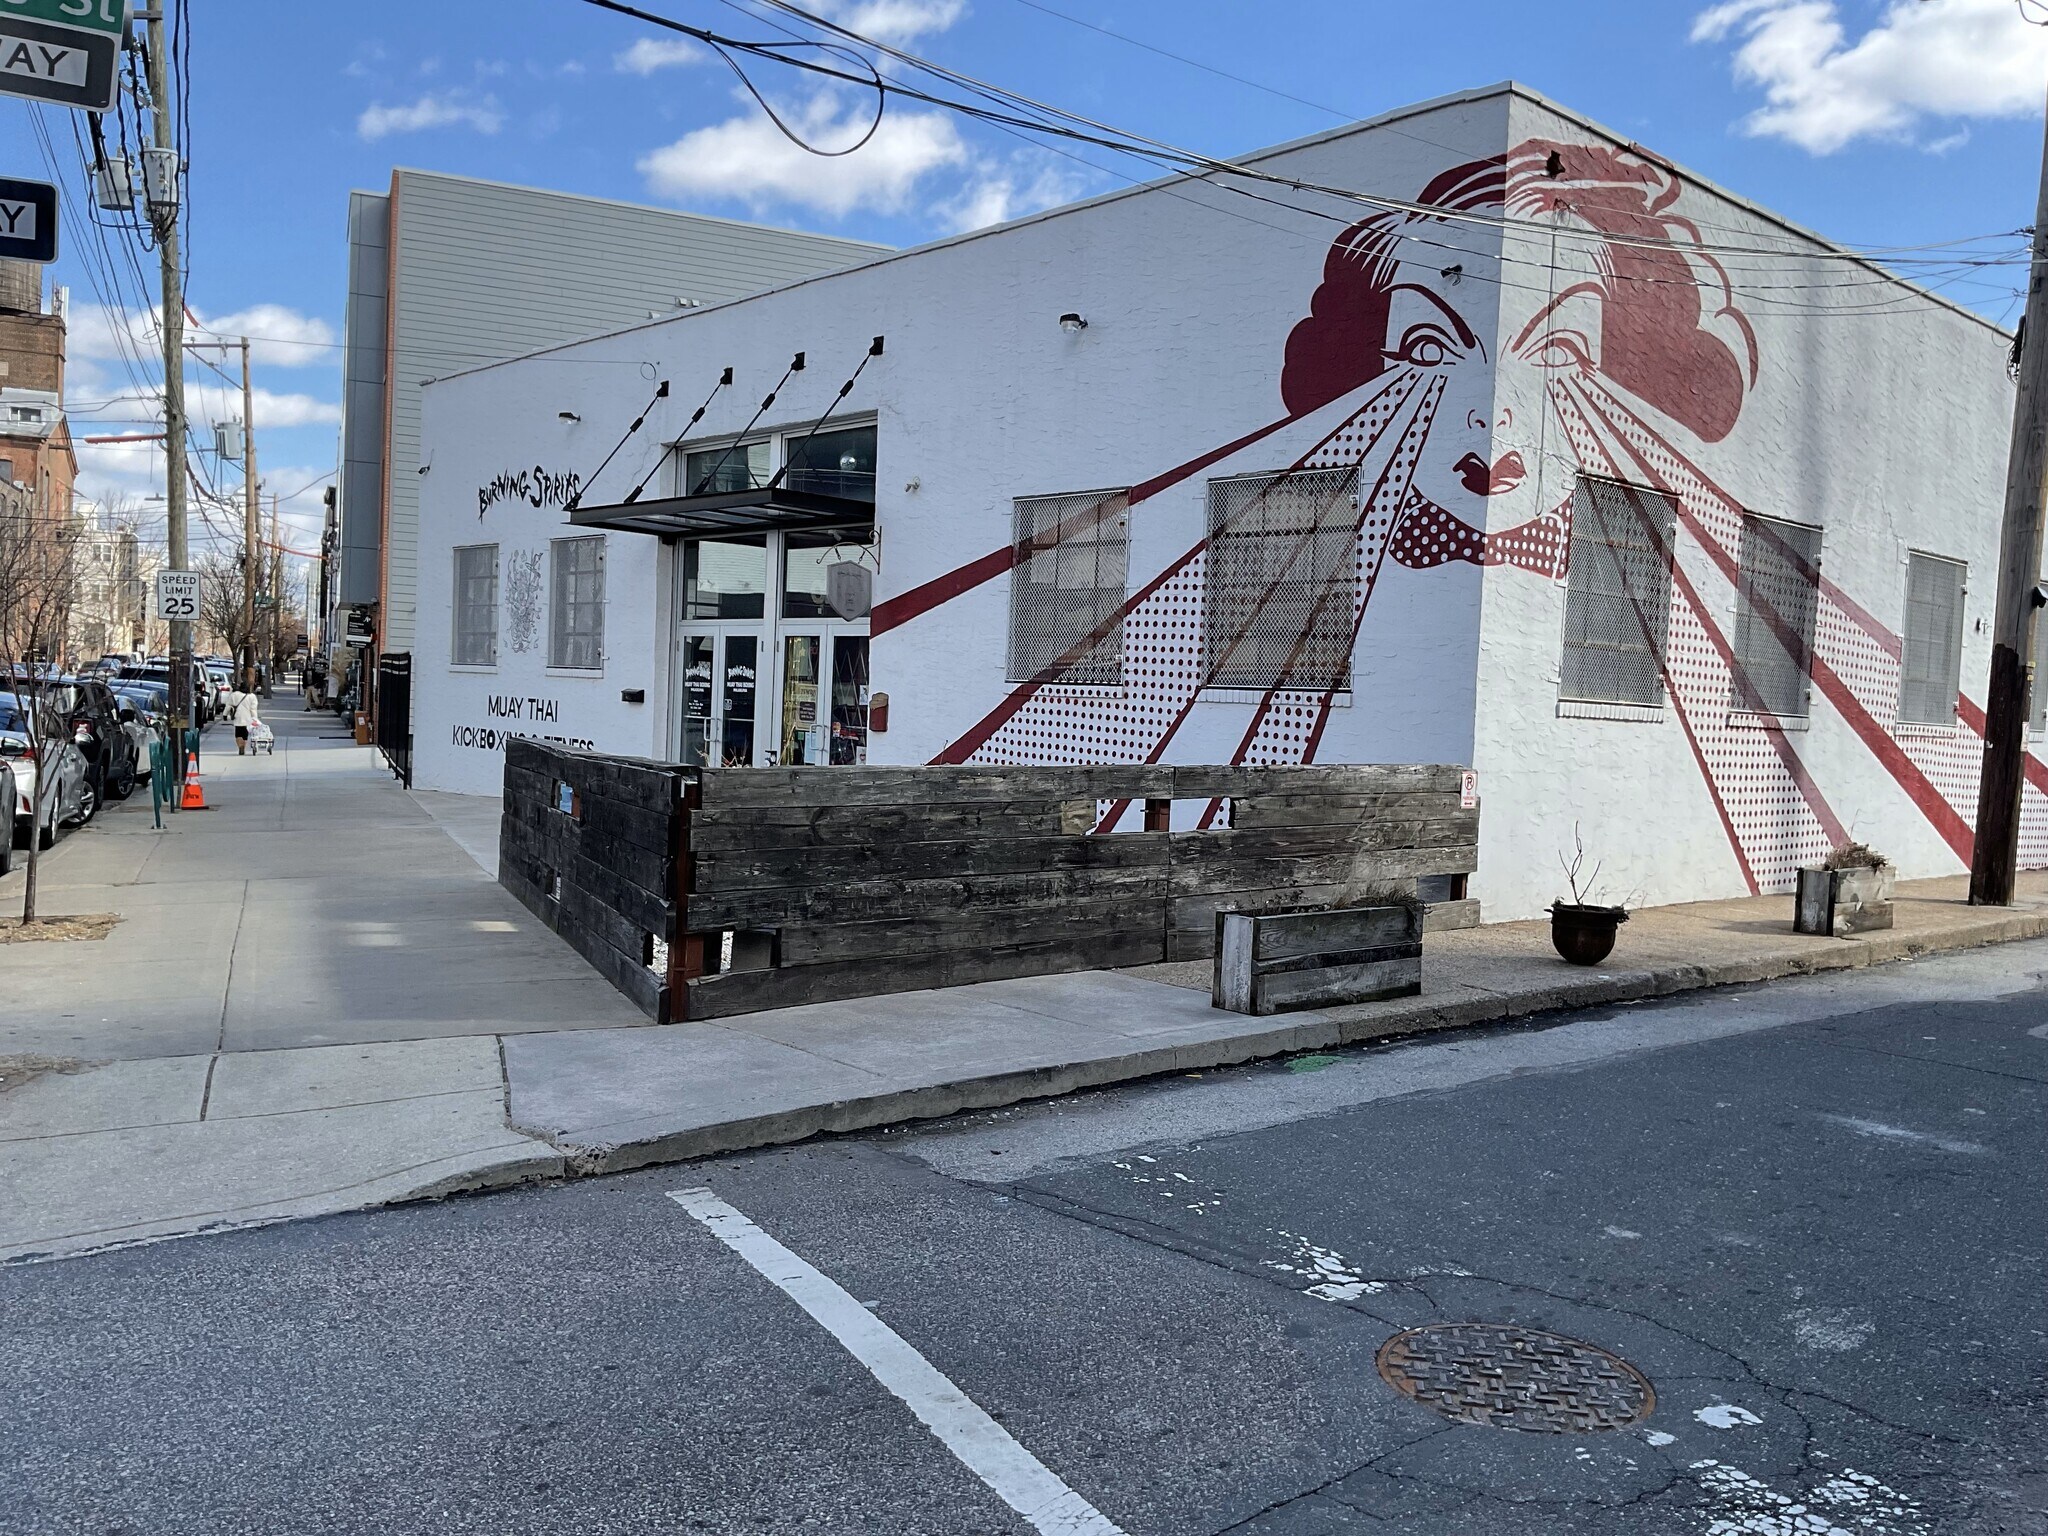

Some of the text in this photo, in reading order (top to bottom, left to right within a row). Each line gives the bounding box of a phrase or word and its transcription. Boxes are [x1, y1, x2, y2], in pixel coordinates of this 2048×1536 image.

[0, 38, 69, 77] AY
[0, 202, 26, 233] Y
[478, 467, 531, 524] BURNING
[162, 575, 196, 585] SPEED
[165, 586, 193, 595] LIMIT
[165, 597, 195, 615] 25
[488, 695, 558, 723] MUAY THAI
[452, 724, 526, 753] KICKBOX
